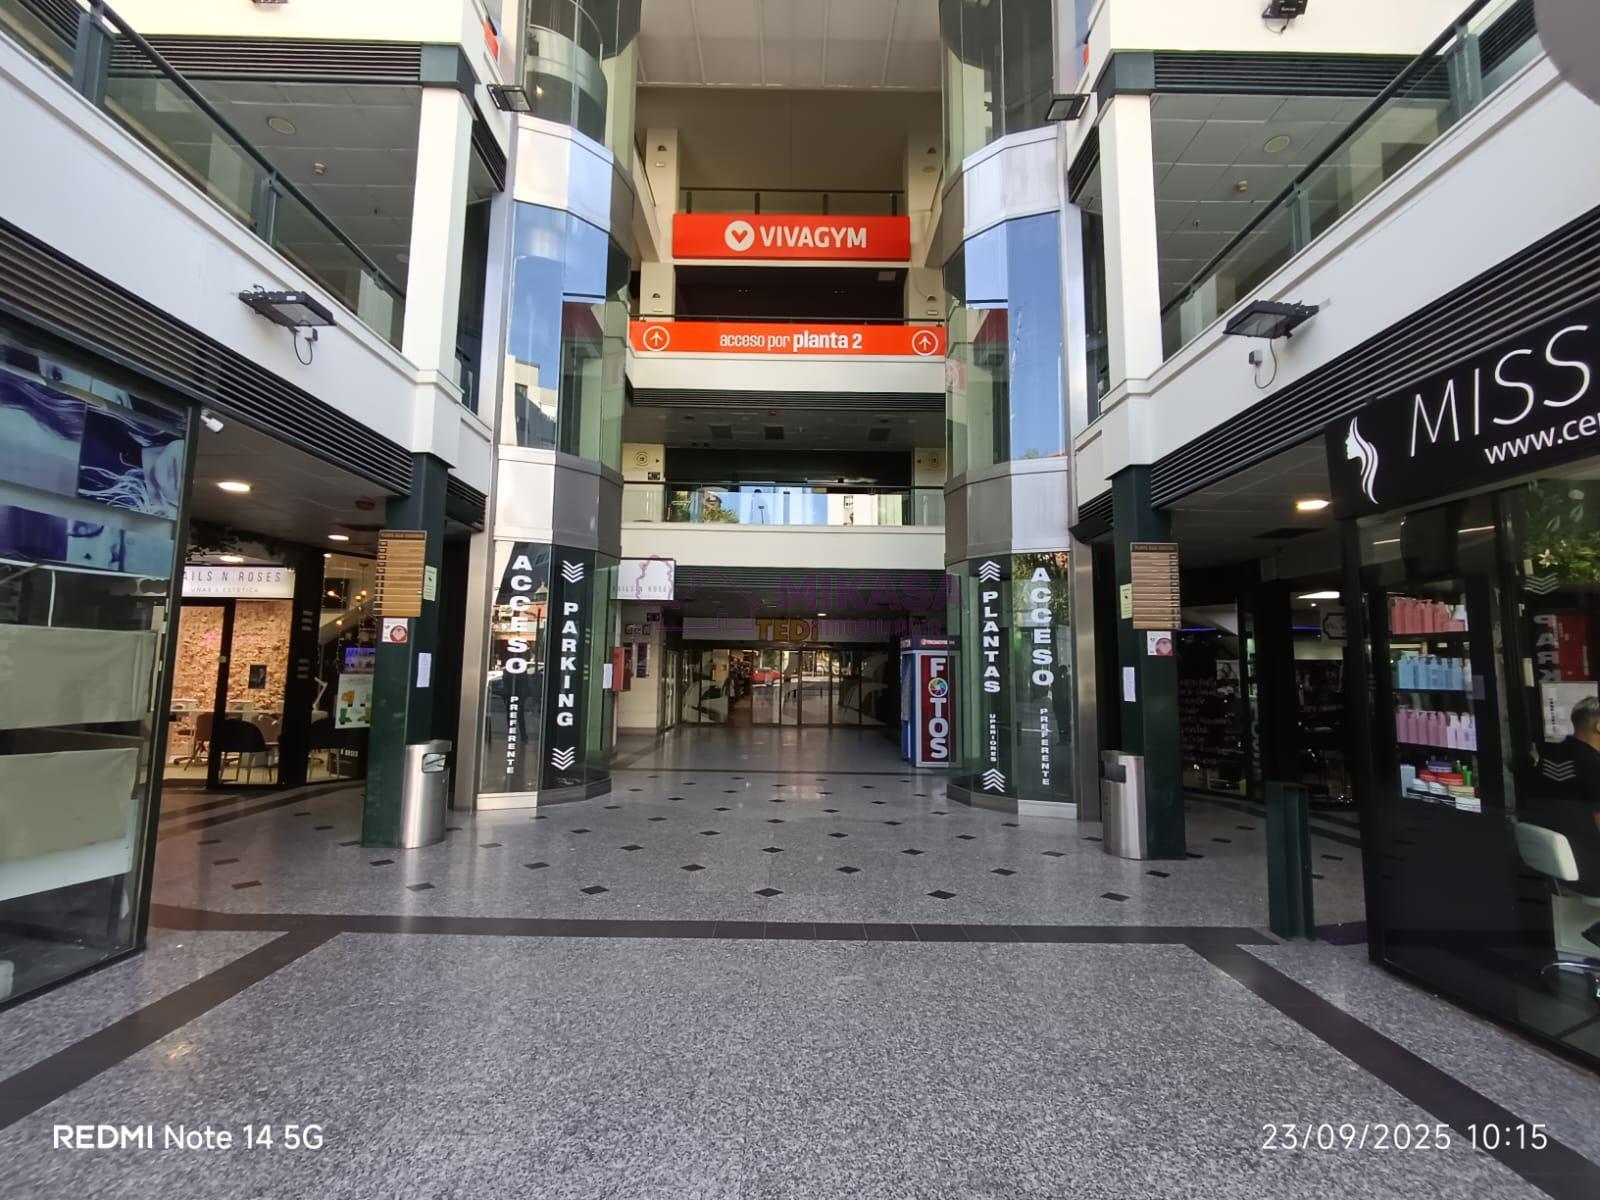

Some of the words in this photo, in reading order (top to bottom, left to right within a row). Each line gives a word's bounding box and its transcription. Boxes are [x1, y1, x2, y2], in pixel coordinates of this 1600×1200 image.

[759, 226, 867, 248] VIVAGYM
[719, 333, 765, 348] acceso
[767, 335, 790, 351] por
[792, 330, 849, 353] planta
[851, 333, 863, 349] 2
[1410, 324, 1591, 457] MISS
[238, 571, 281, 583] ROSES
[505, 555, 533, 674] ACCESO
[1031, 567, 1055, 686] ACCESO
[556, 602, 580, 727] PARKING
[982, 591, 1001, 693] PLANTAS
[506, 696, 519, 774] PREFERENTE
[928, 657, 949, 759] FOTOS
[1039, 708, 1050, 786] PREFERENTE
